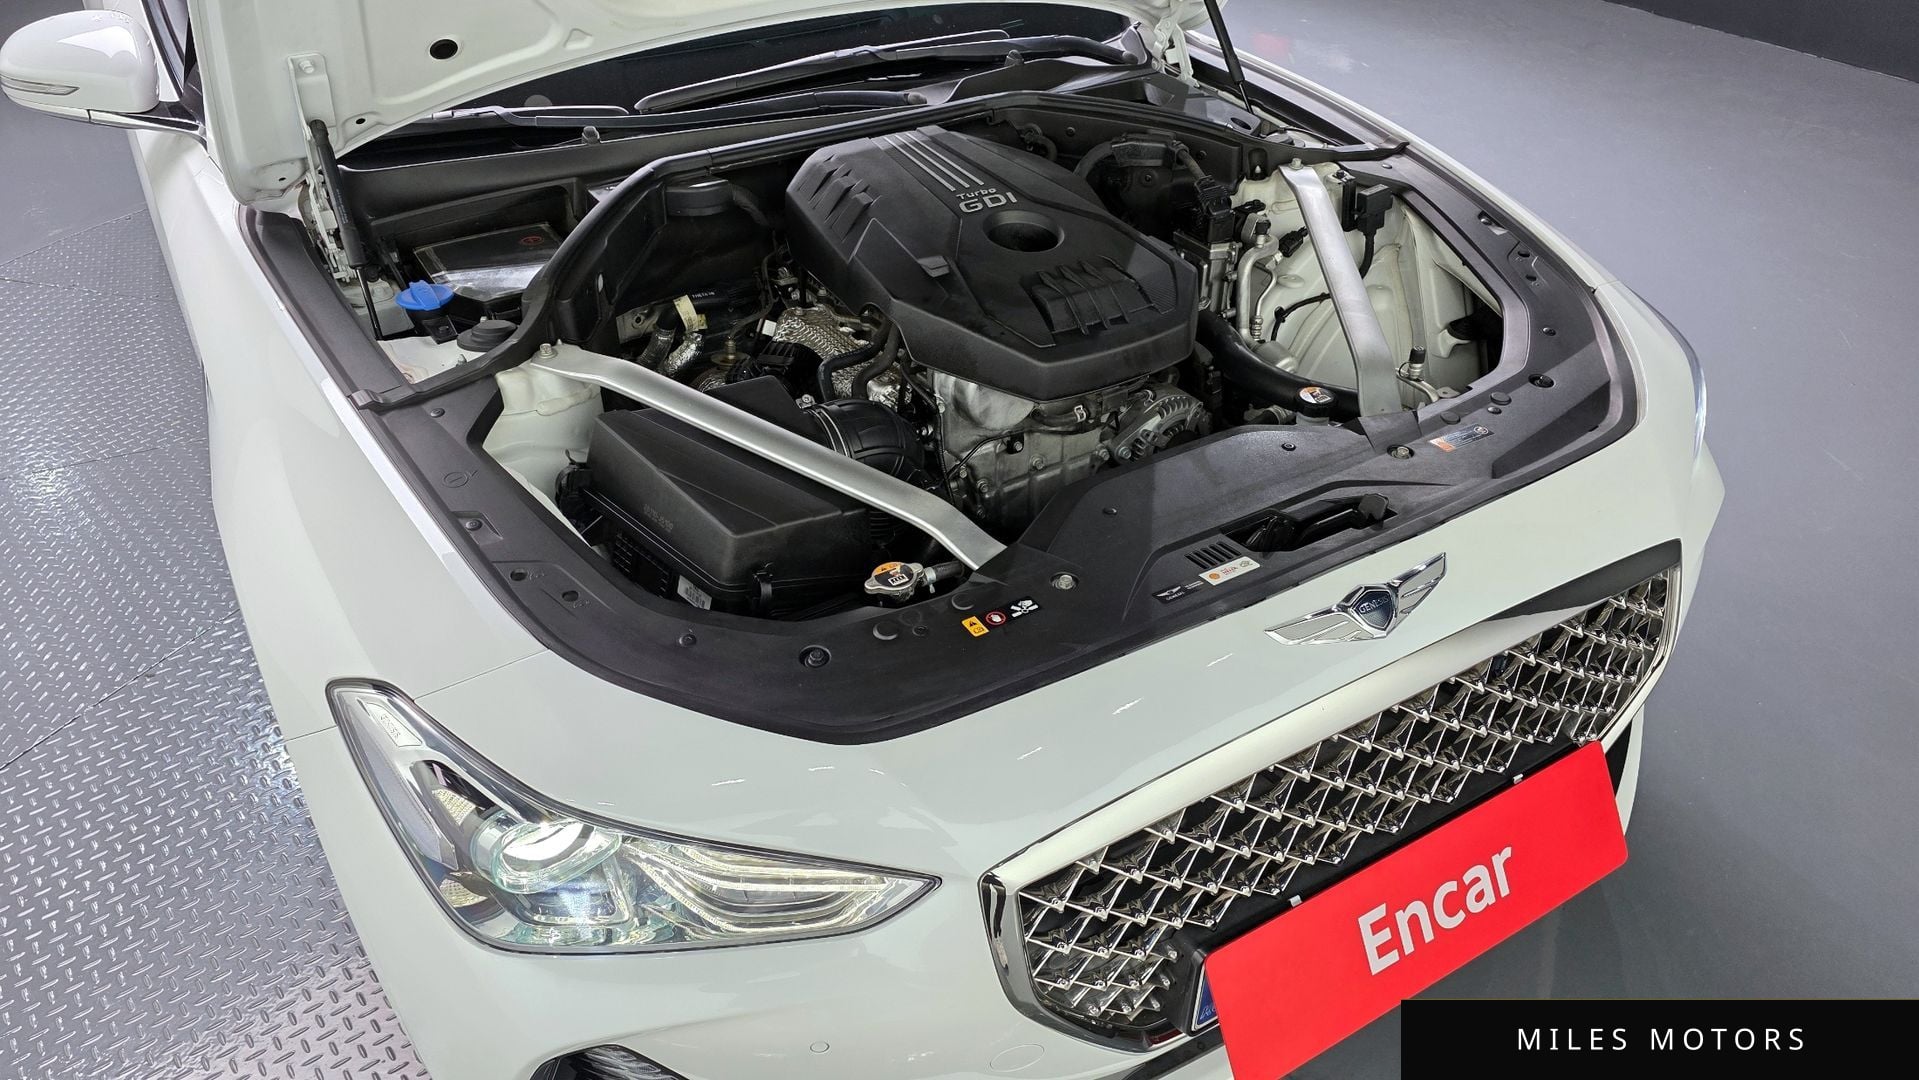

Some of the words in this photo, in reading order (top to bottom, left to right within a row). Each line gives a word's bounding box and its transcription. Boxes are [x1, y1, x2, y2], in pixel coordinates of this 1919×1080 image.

[956, 188, 997, 199] Turbo
[959, 192, 1018, 213] GDI
[1358, 595, 1389, 613] GENESIS
[1358, 847, 1512, 976] Encar
